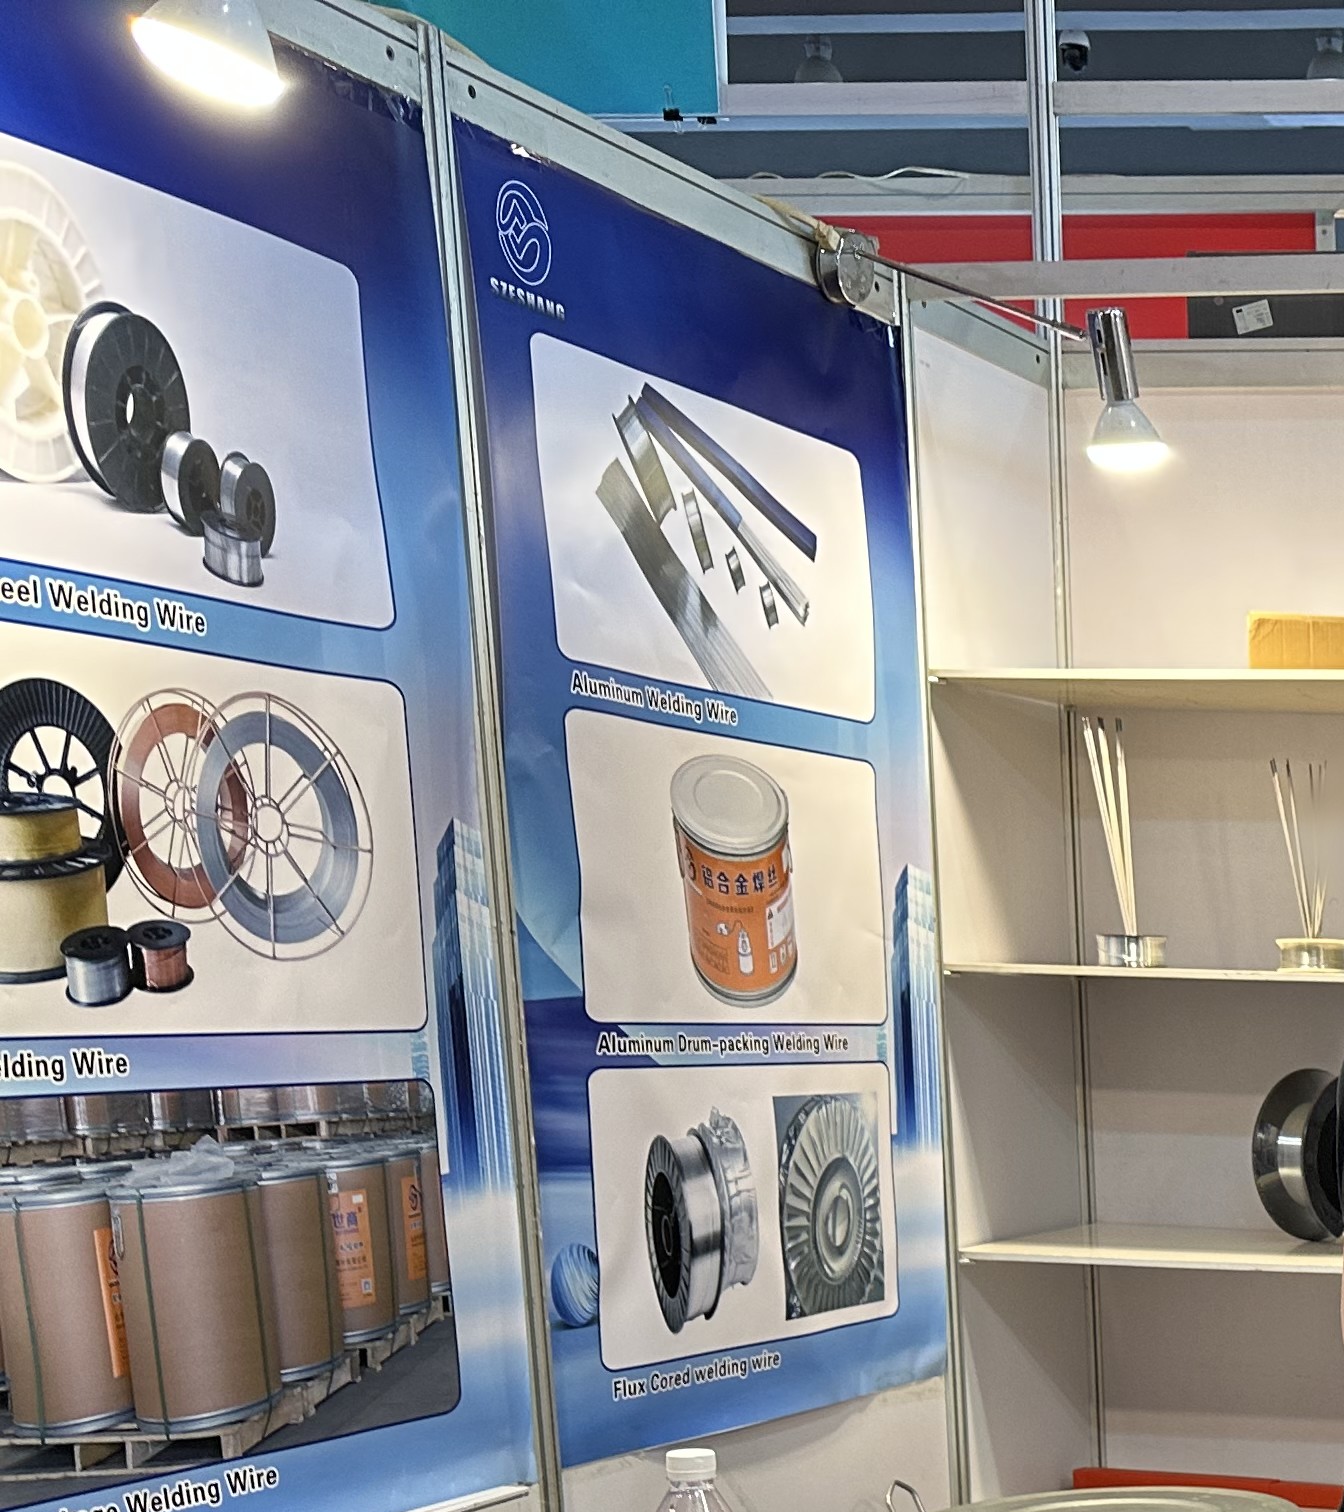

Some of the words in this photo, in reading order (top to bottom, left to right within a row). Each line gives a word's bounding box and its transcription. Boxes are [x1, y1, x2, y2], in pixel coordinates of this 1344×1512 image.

[48, 582, 149, 628] Welding
[156, 600, 206, 633] Wire
[572, 672, 643, 706] Aluminum
[647, 689, 701, 722] Welding
[706, 699, 738, 724] Wire
[72, 1050, 128, 1076] Wire
[598, 1032, 674, 1054] Aluminum
[678, 1034, 769, 1056] Drum-packing
[772, 1033, 820, 1055] Welding
[823, 1034, 849, 1052] Wire
[613, 1380, 646, 1399] Flux
[651, 1367, 691, 1391] Cored
[695, 1357, 748, 1382] welding
[752, 1351, 781, 1370] wire
[226, 1467, 278, 1495] Wire
